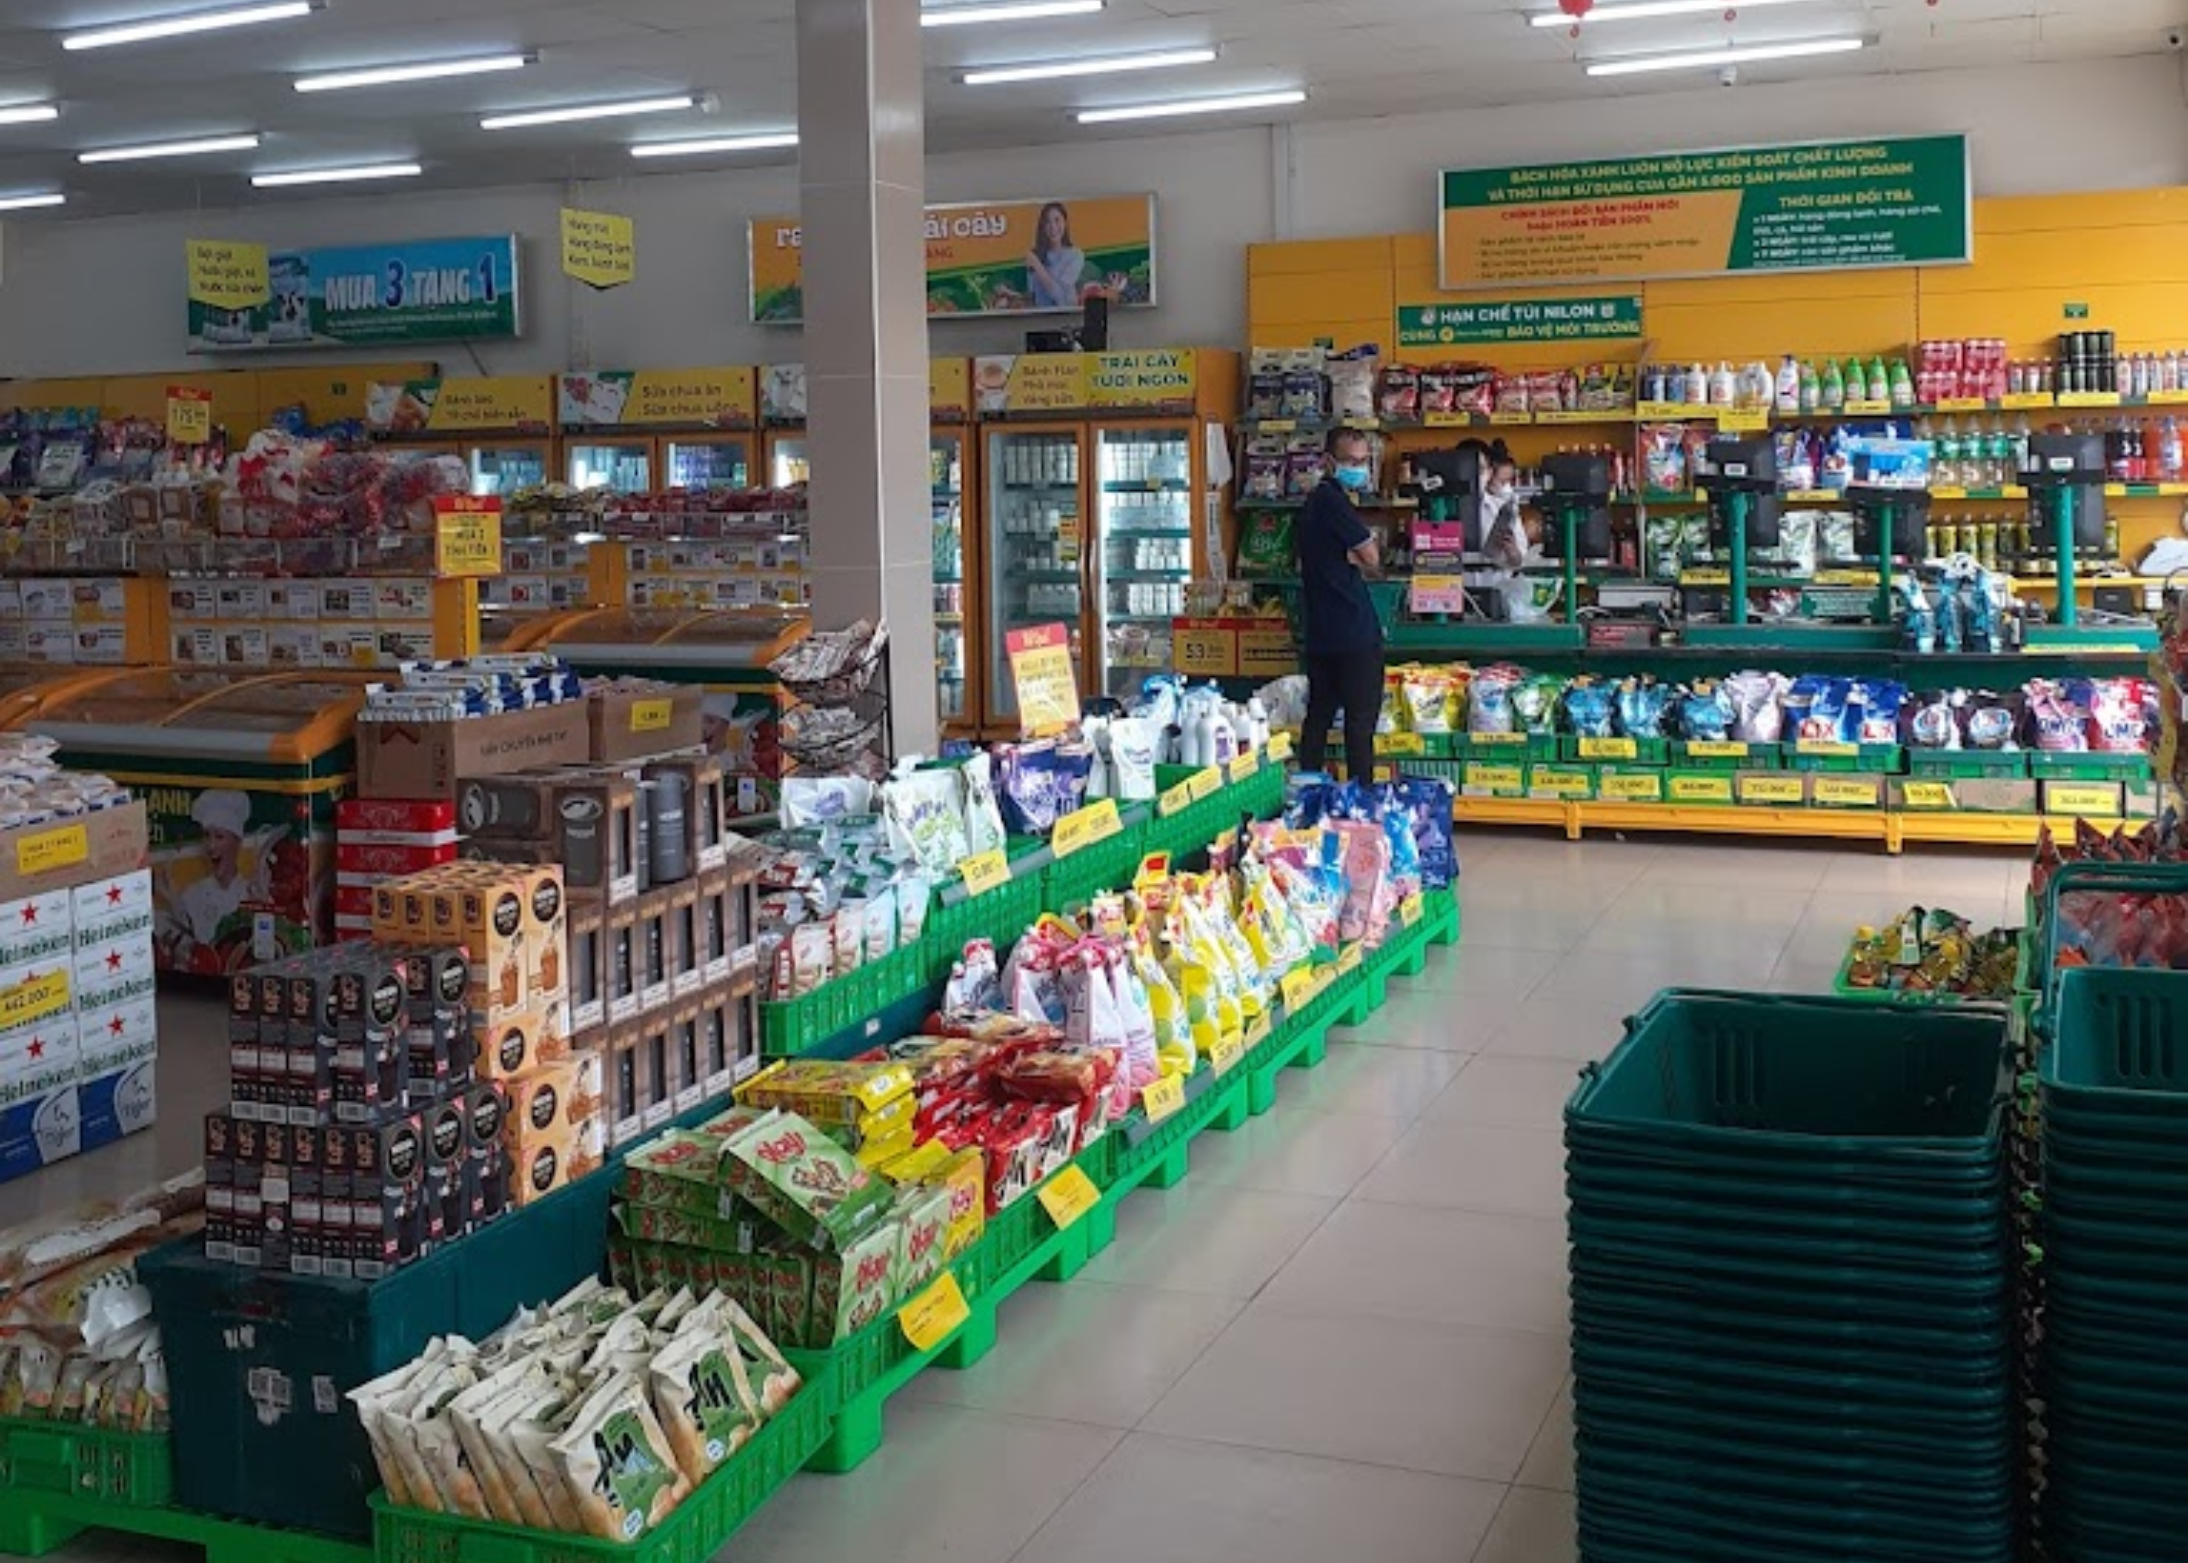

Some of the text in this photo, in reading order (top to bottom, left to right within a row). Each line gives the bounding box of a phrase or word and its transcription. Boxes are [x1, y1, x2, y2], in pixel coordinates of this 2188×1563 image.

[1510, 170, 1547, 184] BÁCH
[1550, 166, 1578, 180] HÓA
[1580, 164, 1619, 179] XANH
[1621, 160, 1659, 176] LUÔN
[1754, 149, 1791, 167] SOÁT
[1793, 146, 1832, 164] CHẤT
[1835, 144, 1888, 163] LƯỢNG
[1595, 181, 1634, 197] DỤNG
[1776, 165, 1818, 182] PHẨM
[1821, 164, 1858, 179] KINH
[1860, 162, 1914, 177] DOANH
[1779, 194, 1814, 208] THỜI
[1816, 192, 1853, 206] GIAN
[953, 211, 1007, 237] cây
[325, 251, 498, 312] MUA 3 TẶNG 1
[1440, 303, 1595, 327] HẠN CHẾ TÚI NILON
[1507, 322, 1534, 338] BẢO
[1535, 321, 1554, 338] VỆ
[1581, 319, 1640, 334] TRƯỜNG
[1099, 352, 1180, 369] TRÁI CÂY
